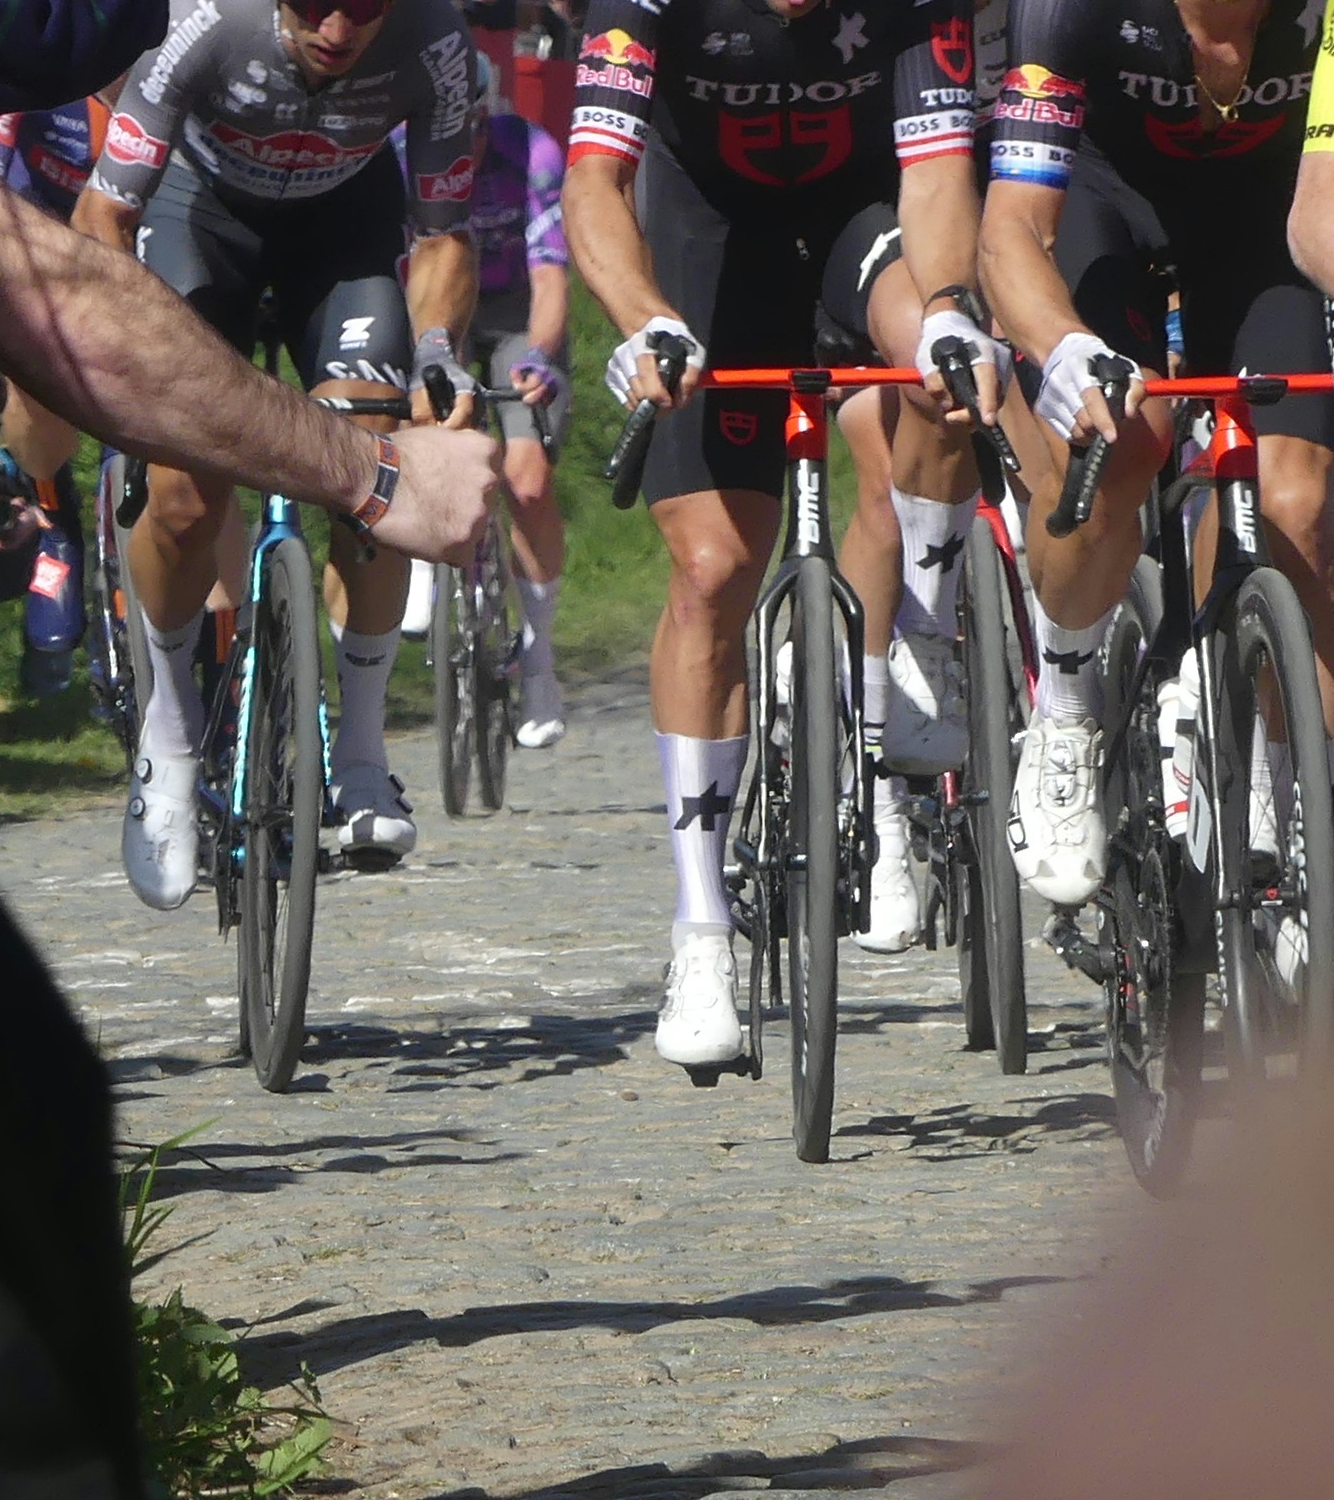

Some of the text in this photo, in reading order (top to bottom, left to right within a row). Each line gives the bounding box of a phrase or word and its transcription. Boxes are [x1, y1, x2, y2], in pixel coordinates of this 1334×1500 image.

[616, 65, 653, 99] Bull
[685, 70, 882, 106] TUDOR
[582, 110, 626, 130] BOSS
[797, 469, 820, 544] BMC
[1232, 481, 1257, 554] BMC
